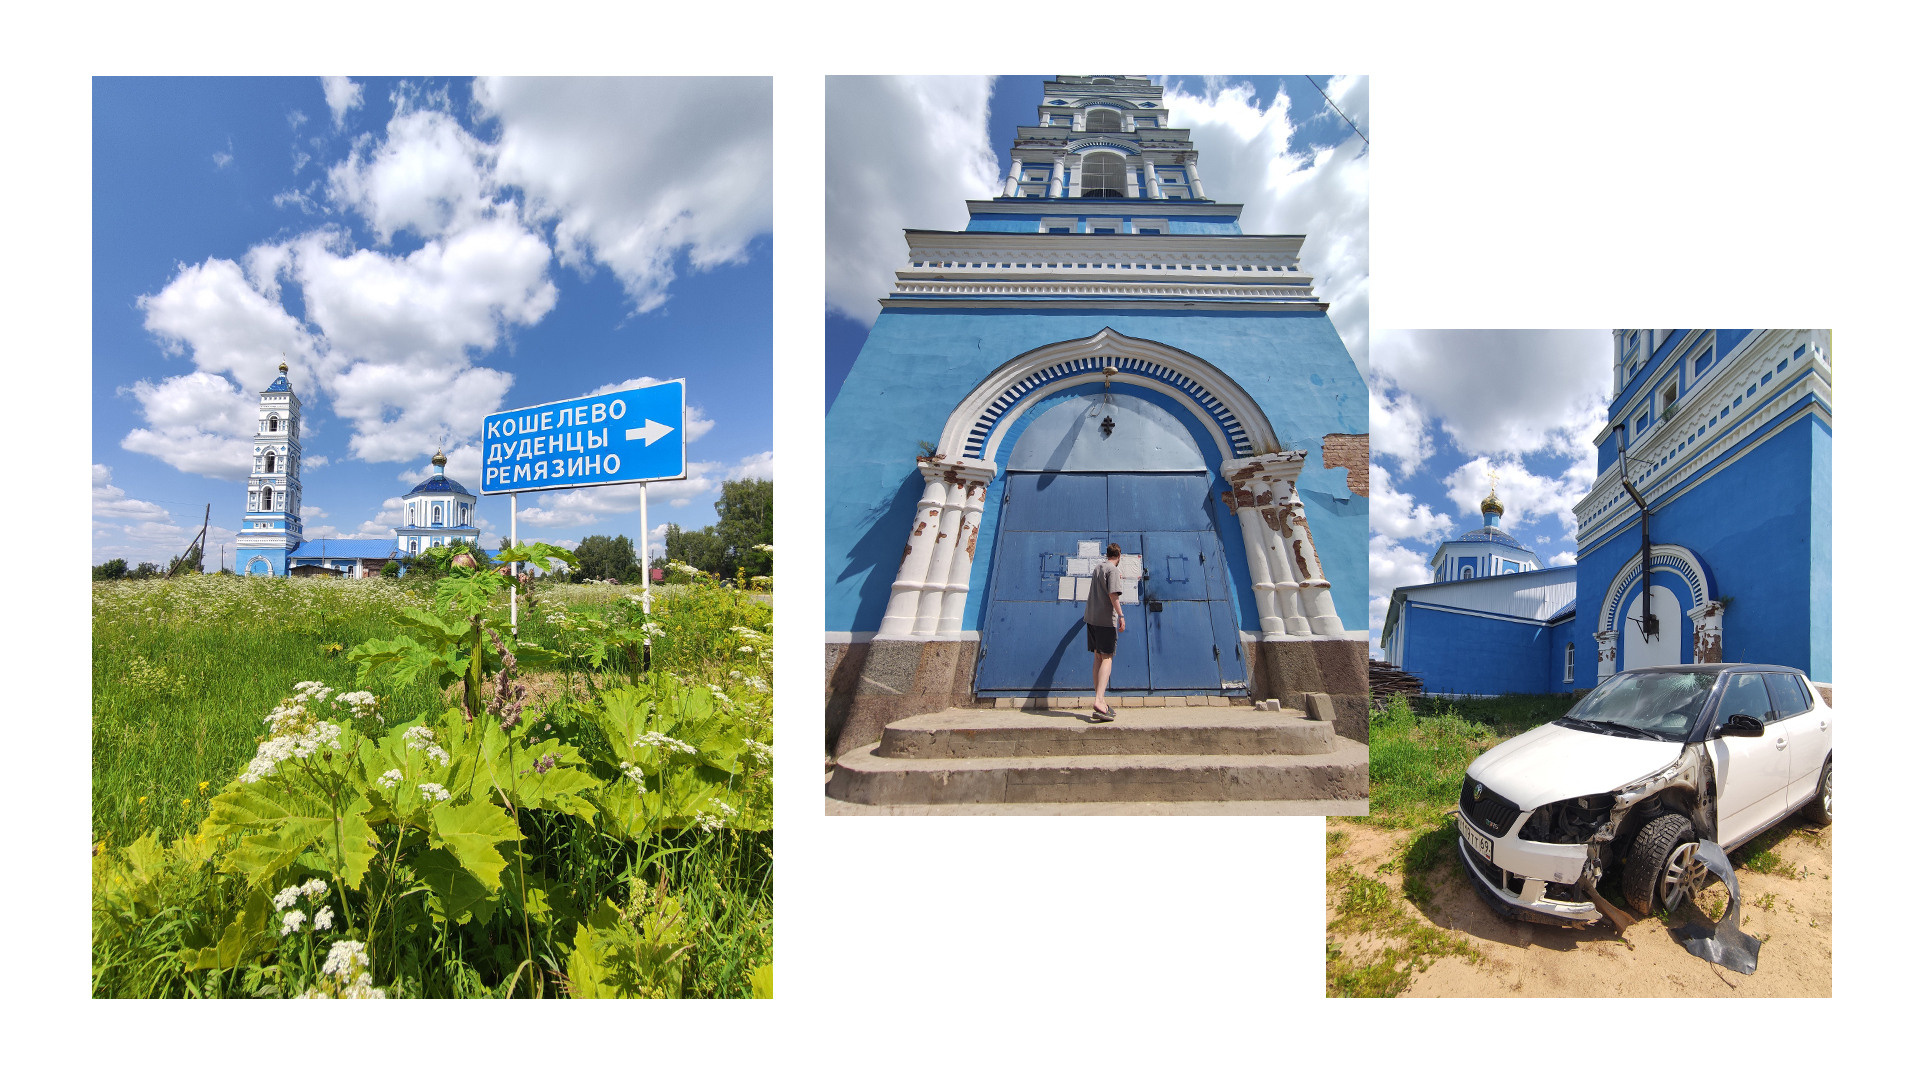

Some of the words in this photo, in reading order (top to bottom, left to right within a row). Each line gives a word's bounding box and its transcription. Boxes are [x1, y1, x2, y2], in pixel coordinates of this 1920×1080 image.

[488, 399, 627, 439] КОШЕЛЕВО
[487, 427, 608, 465] ДУДЕНЦЫ
[486, 453, 621, 486] РЕМЯЗИНО
